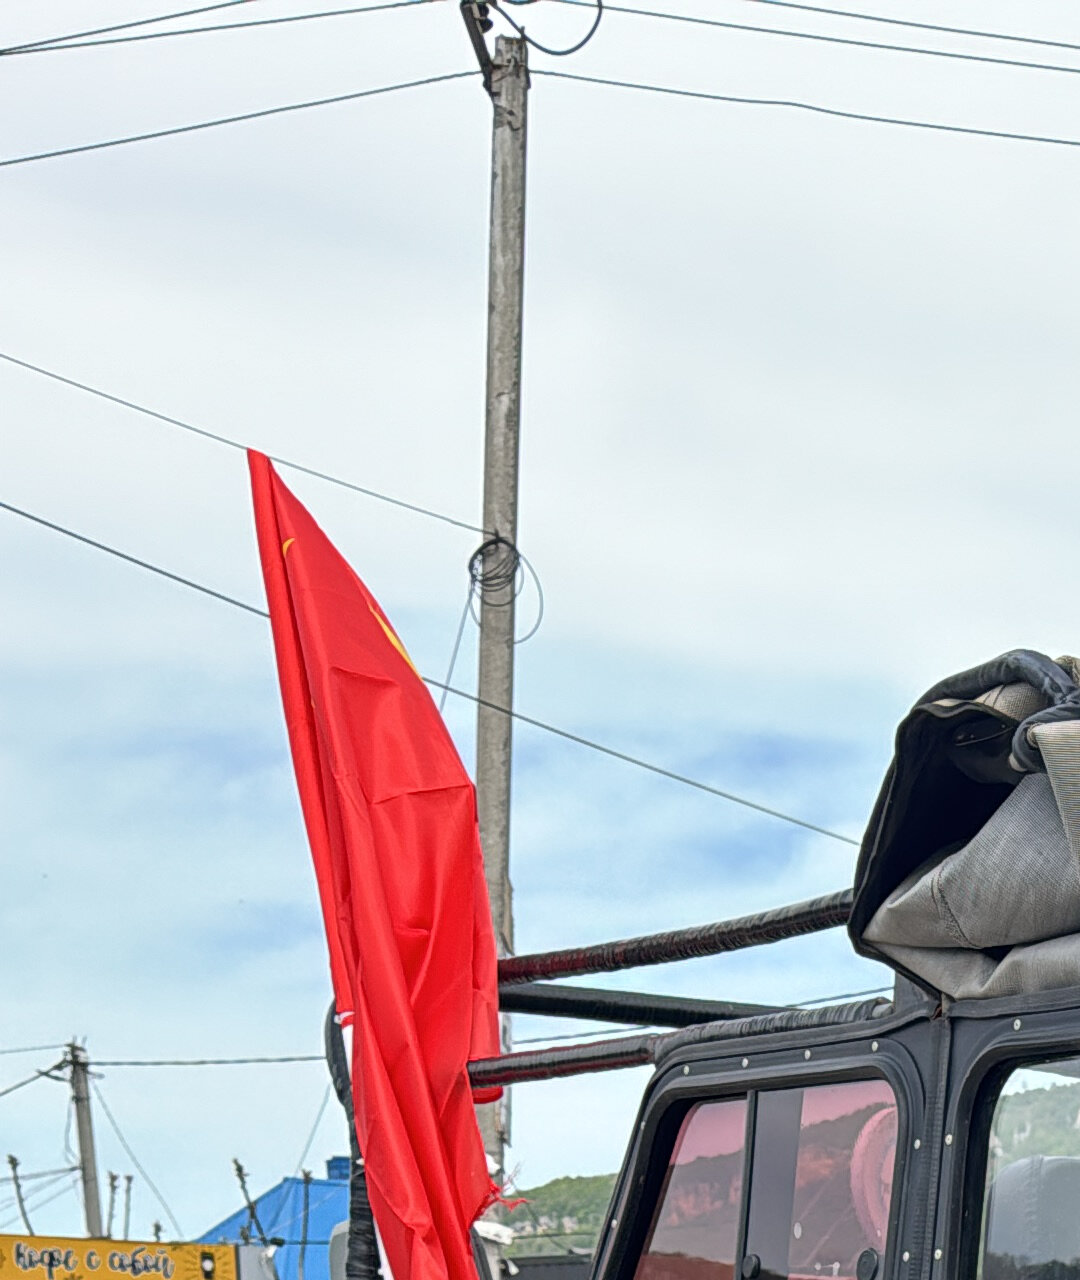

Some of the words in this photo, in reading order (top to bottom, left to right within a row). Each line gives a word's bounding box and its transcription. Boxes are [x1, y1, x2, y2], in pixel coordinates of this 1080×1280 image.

[14, 1242, 78, 1280] Кофе
[86, 1250, 100, 1270] с
[107, 1246, 175, 1280] собой
